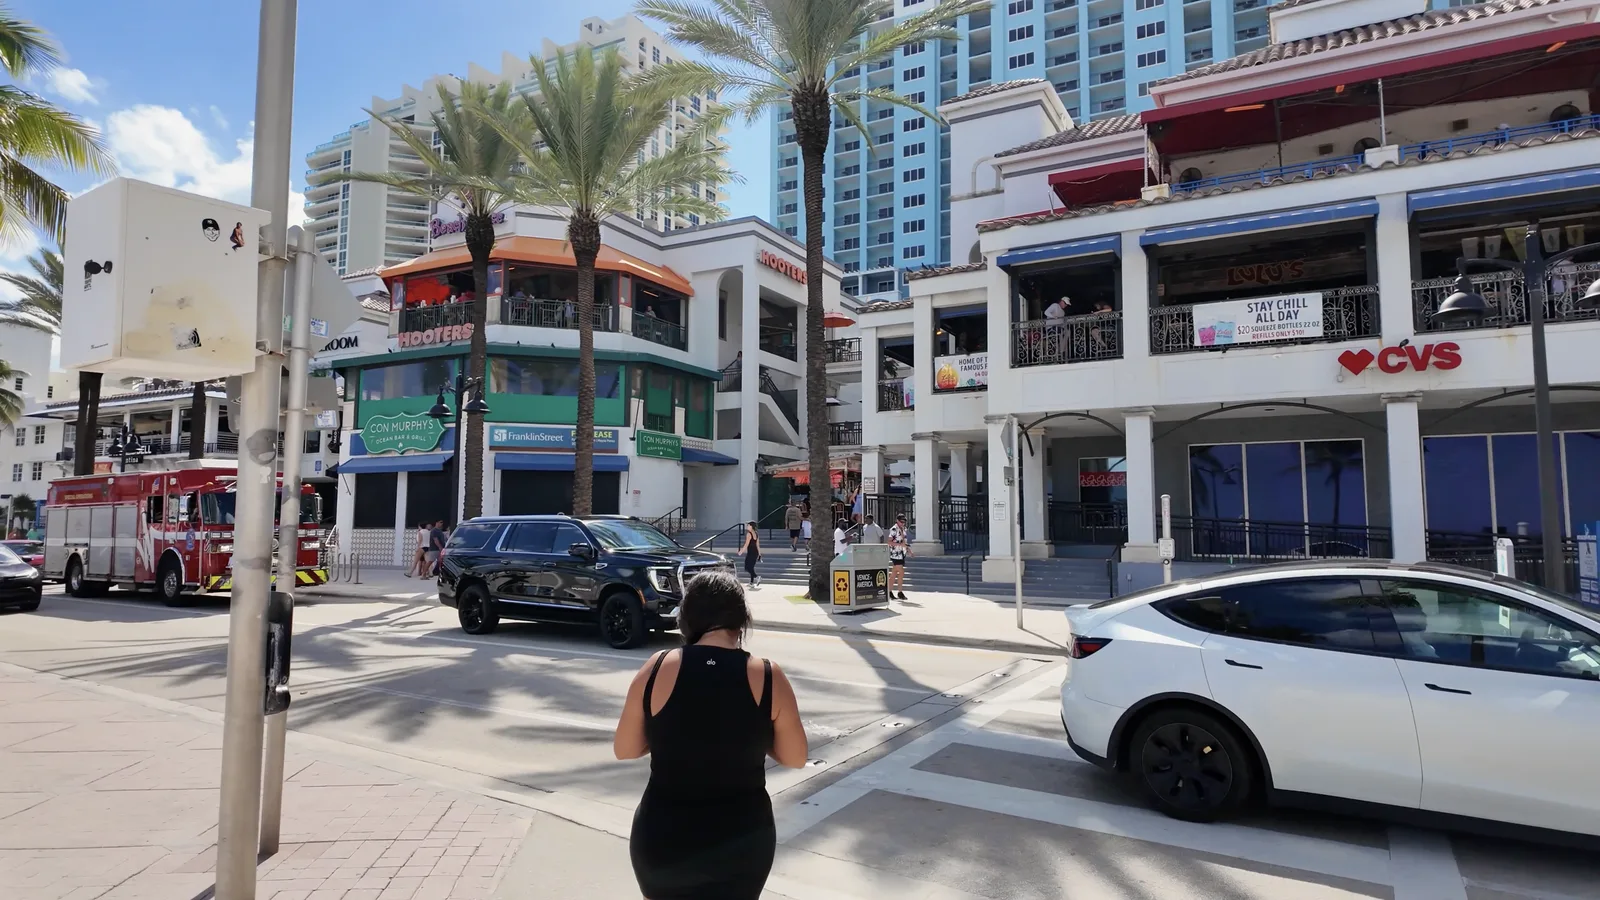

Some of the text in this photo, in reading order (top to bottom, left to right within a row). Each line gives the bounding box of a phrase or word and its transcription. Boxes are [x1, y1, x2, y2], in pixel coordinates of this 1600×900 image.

[761, 249, 808, 285] HOOTERS
[1227, 260, 1304, 286] LULU'S
[1247, 298, 1308, 313] STAY CHILL
[1255, 309, 1299, 324] ALL DAY
[1237, 325, 1250, 335] $20
[1251, 323, 1276, 332] SQUEEZE
[1278, 322, 1303, 330] BOTTLES
[399, 323, 474, 348] HOOTERS
[1252, 331, 1274, 340] REFILLS
[1275, 330, 1291, 338] ONLY
[976, 356, 984, 364] OF
[1378, 342, 1462, 374] CVS
[370, 422, 389, 434] CON
[593, 430, 613, 438] EASE
[376, 436, 393, 444] OCEAN
[508, 431, 564, 442] FranklinStreet
[643, 435, 655, 443] CON
